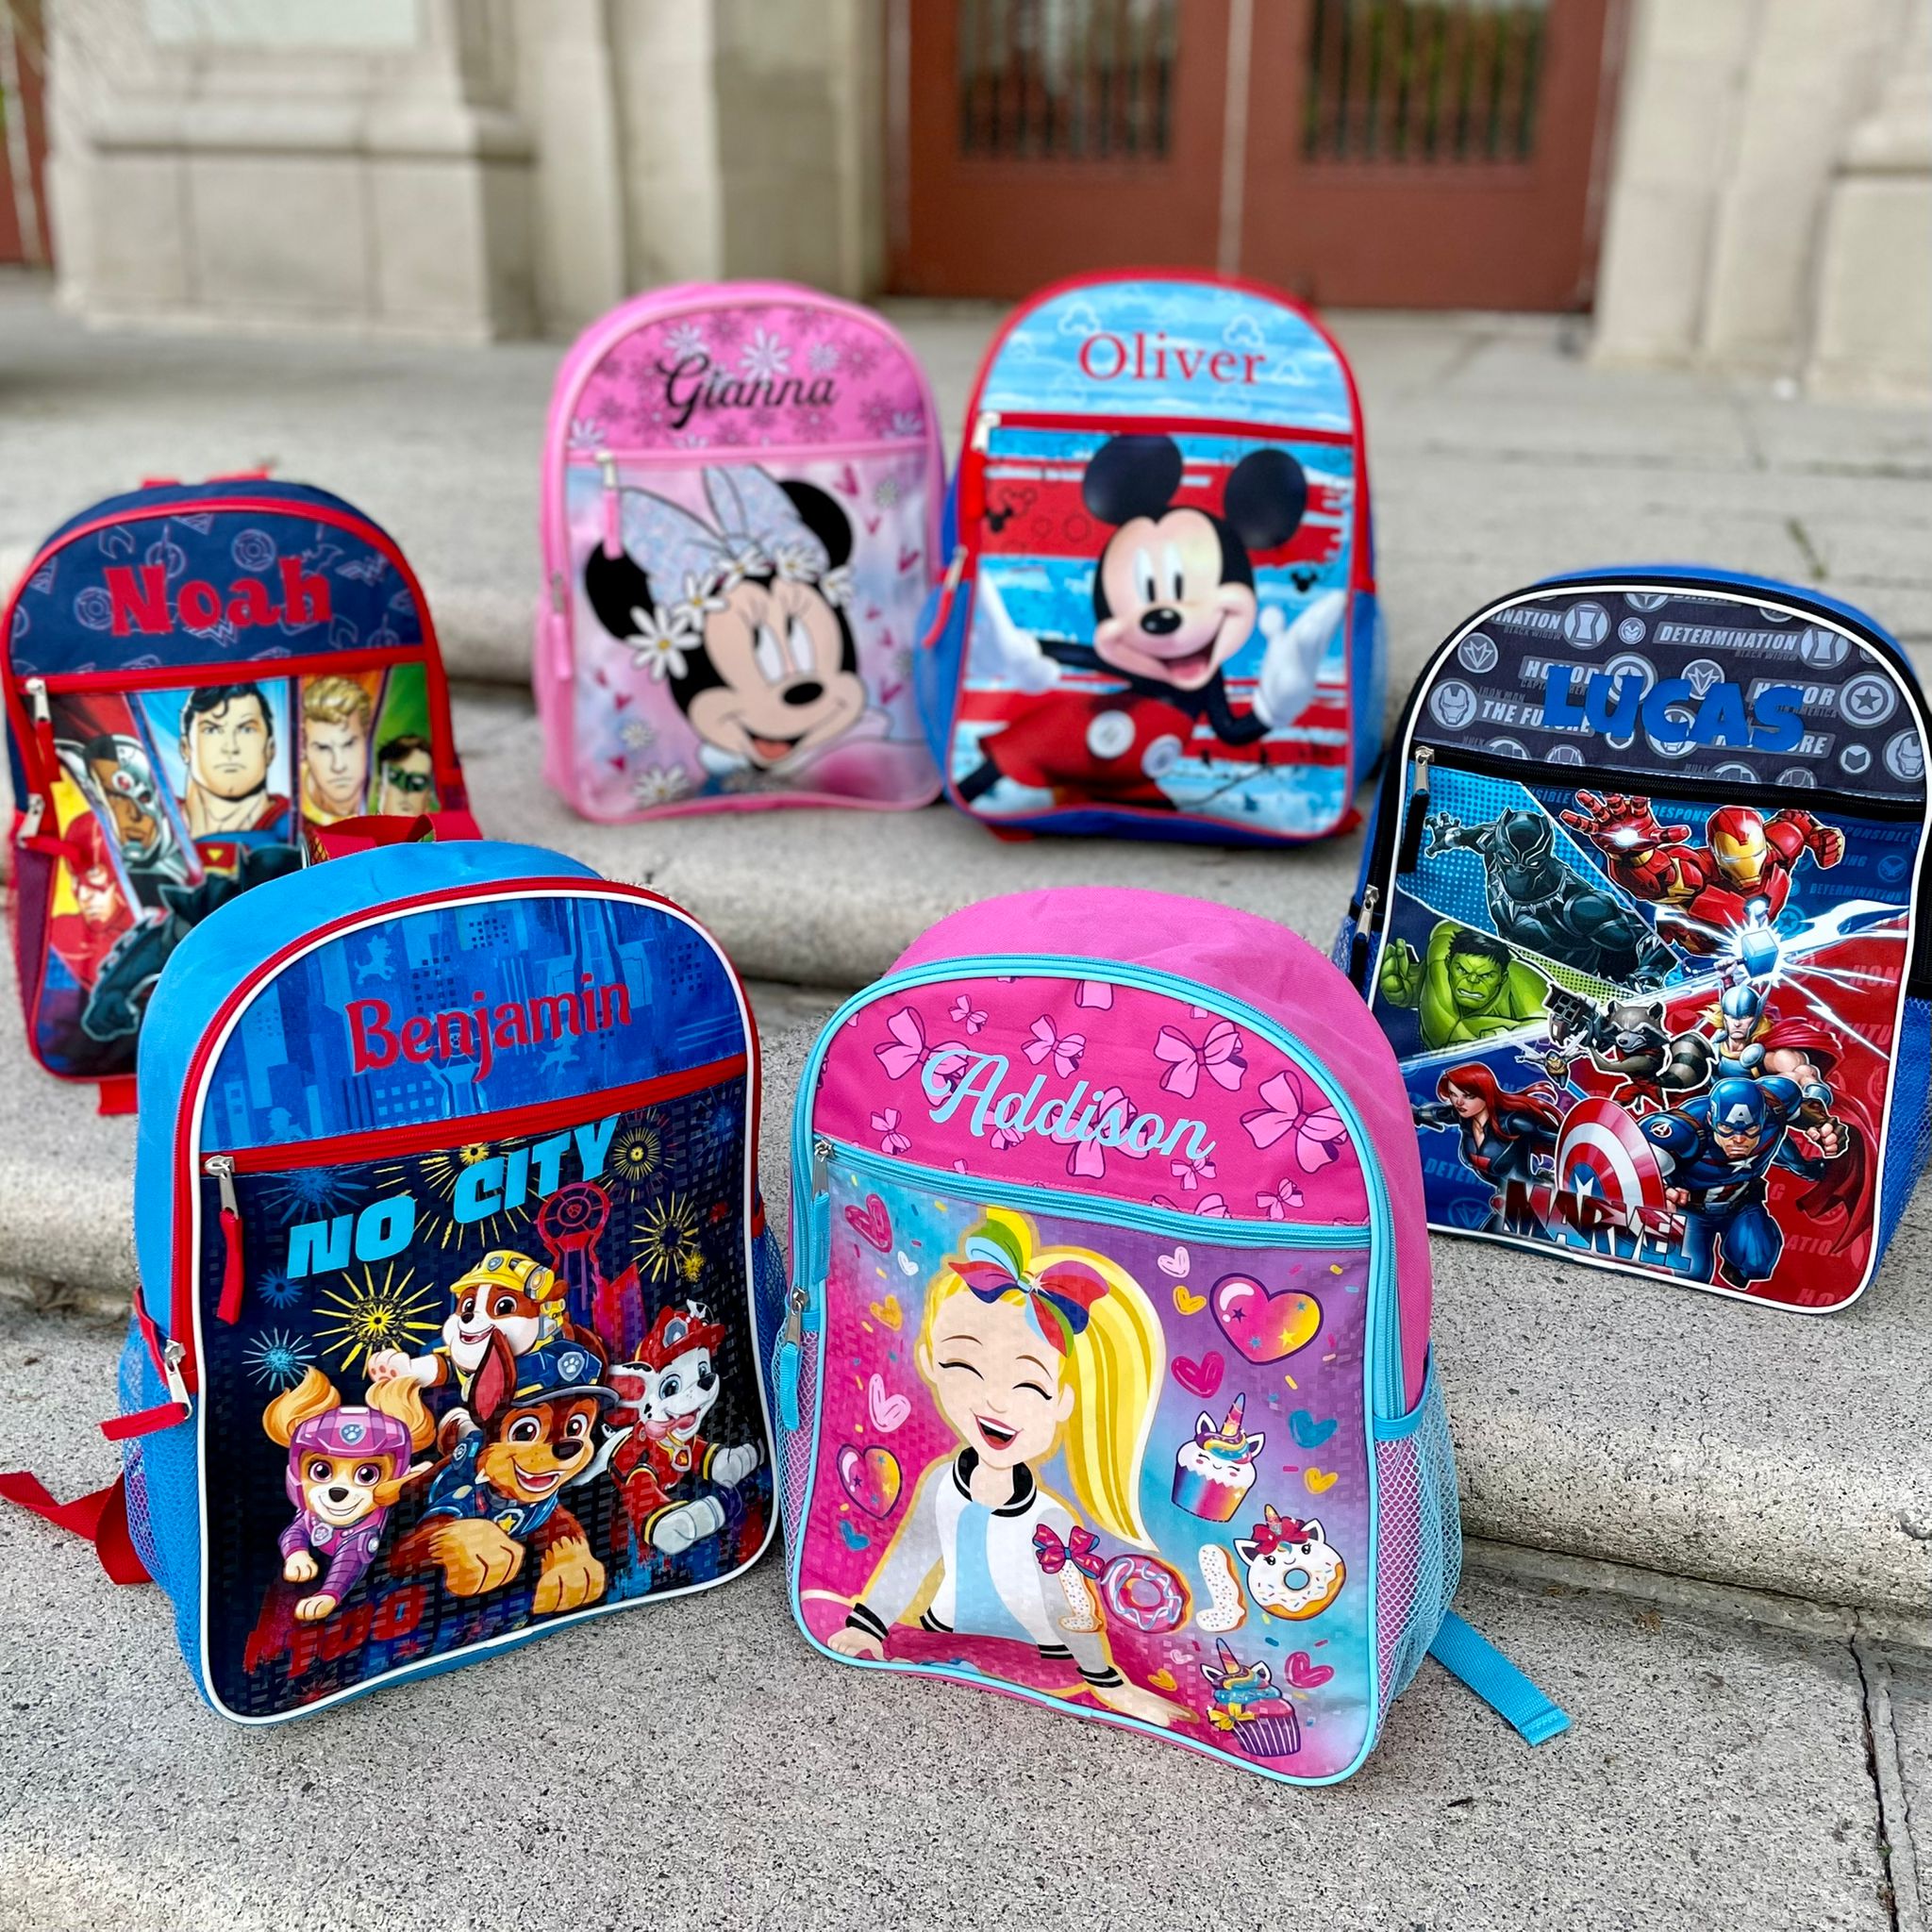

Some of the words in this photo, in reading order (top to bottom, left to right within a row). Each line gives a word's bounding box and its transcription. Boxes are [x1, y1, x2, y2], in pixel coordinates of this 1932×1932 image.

[658, 355, 842, 430] Gianna
[1079, 332, 1266, 387] Oliver
[105, 558, 331, 637] Noah
[1491, 609, 1562, 630] INATION
[1659, 625, 1798, 651] DETERMINATION
[1482, 700, 1517, 723] THE
[1543, 665, 1806, 752] LUCAS
[346, 973, 632, 1082] Benjamin
[921, 1049, 1217, 1159] Addison
[287, 1194, 417, 1279] NO
[454, 1112, 621, 1224] CITY
[1503, 1178, 1691, 1273] MARVEL
